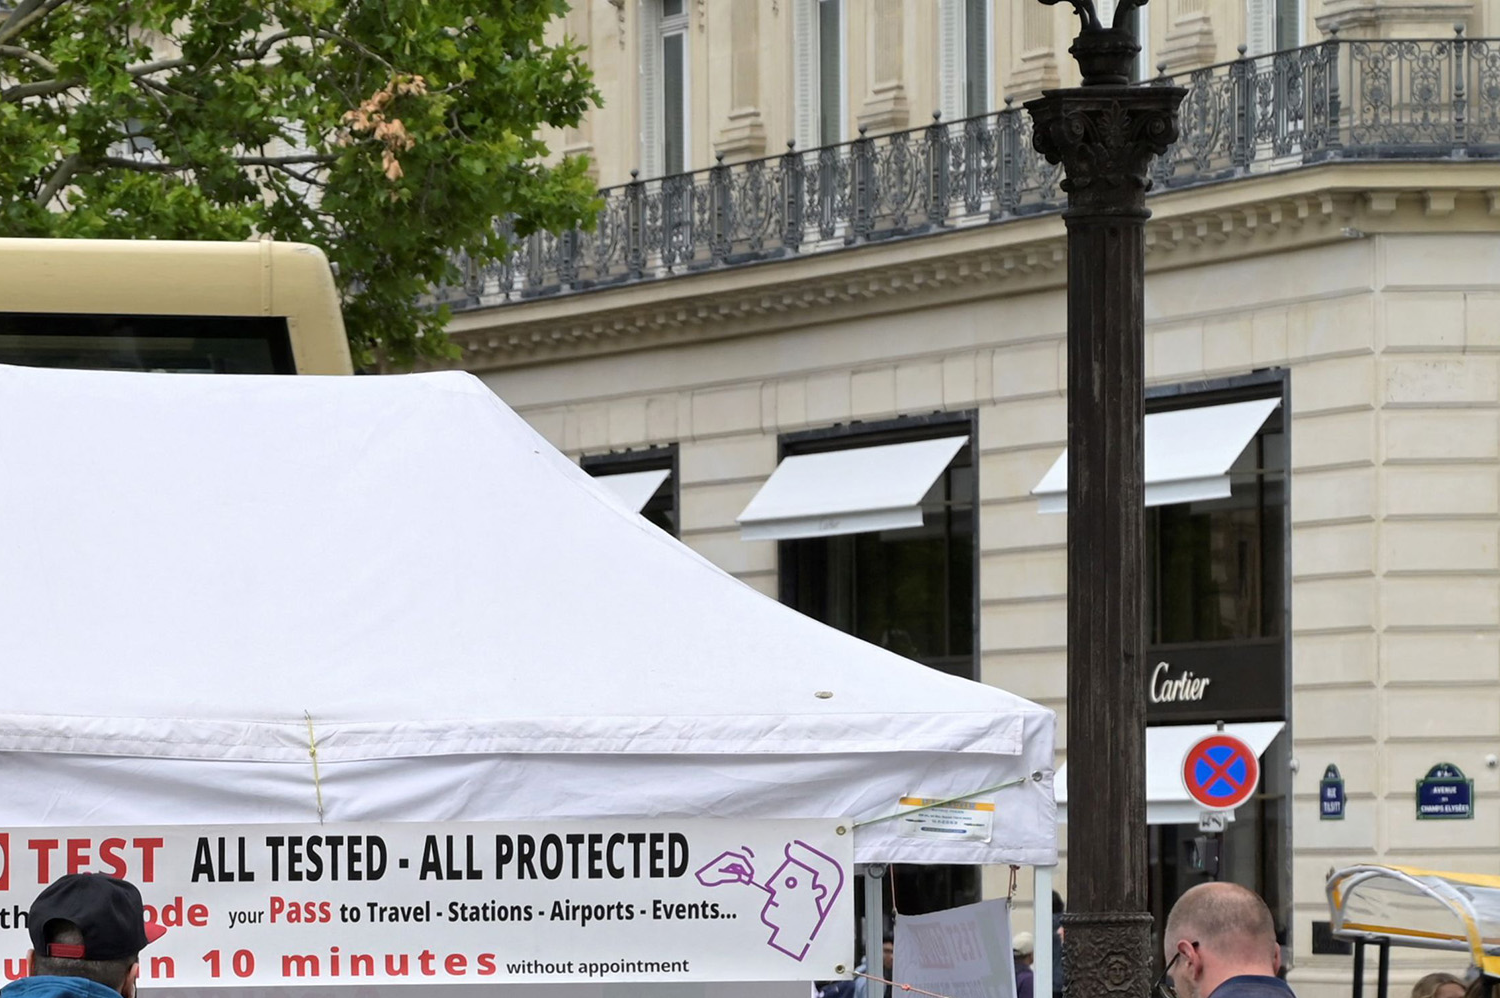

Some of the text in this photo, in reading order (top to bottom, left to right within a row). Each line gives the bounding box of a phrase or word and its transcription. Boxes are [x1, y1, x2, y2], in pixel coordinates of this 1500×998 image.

[1151, 661, 1210, 703] Cartier
[1432, 786, 1457, 794] AVENUE
[1420, 804, 1443, 812] CHAMPS
[28, 837, 164, 884] TEST
[190, 836, 255, 883] ALL
[265, 835, 388, 882] TESTED
[419, 834, 483, 881] ALL
[495, 832, 690, 880] PROTECTED
[229, 910, 265, 929] your
[269, 896, 332, 924] Pass
[340, 903, 361, 923] to
[367, 900, 431, 923] Travel
[448, 899, 533, 923] Stations
[550, 898, 635, 928] Airports
[653, 899, 737, 921] Events...
[136, 942, 175, 979] n
[203, 949, 255, 978] 10
[281, 946, 496, 977] minutes
[506, 959, 574, 974] without
[579, 959, 690, 978] appointment
